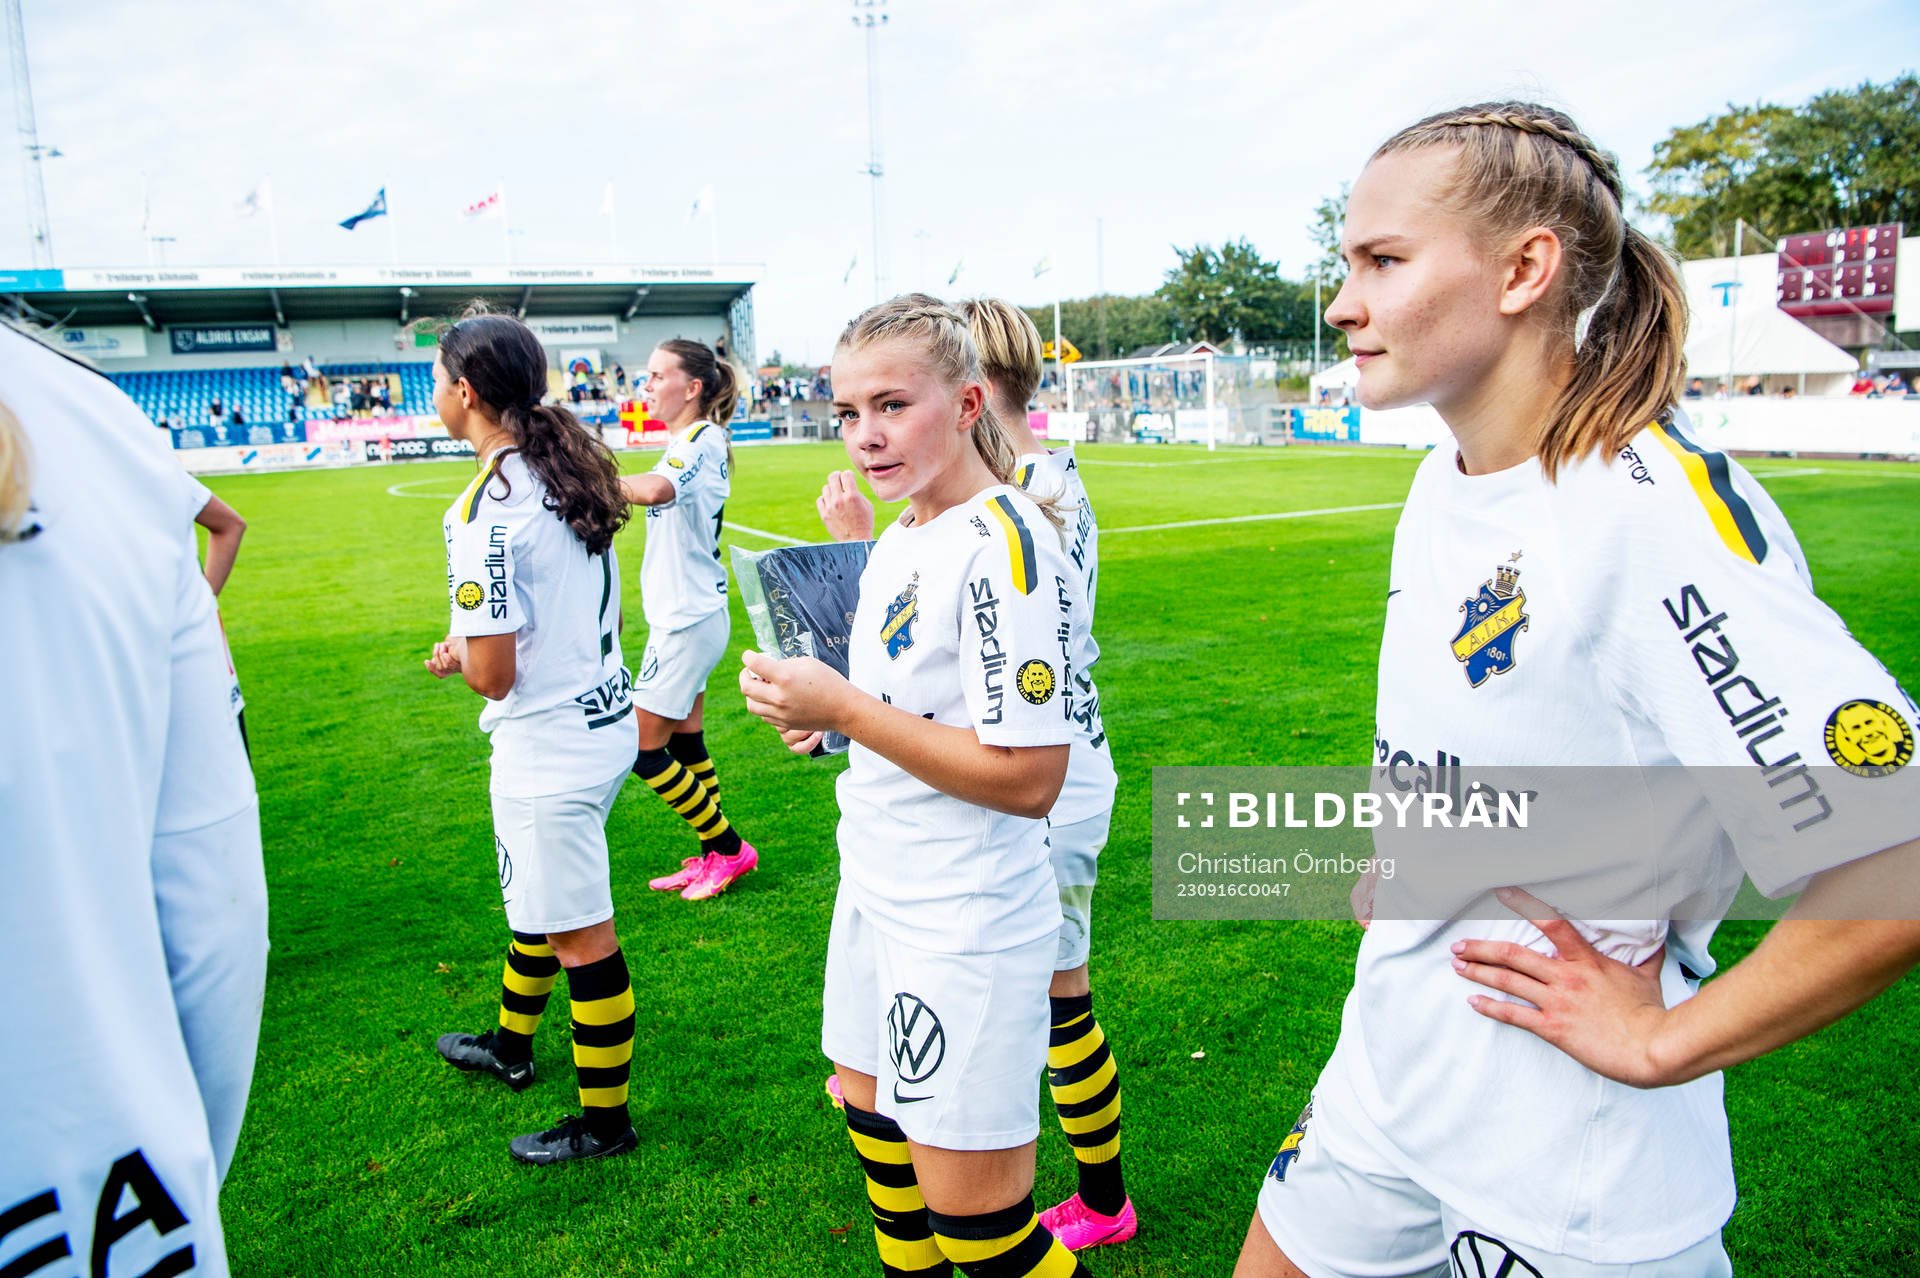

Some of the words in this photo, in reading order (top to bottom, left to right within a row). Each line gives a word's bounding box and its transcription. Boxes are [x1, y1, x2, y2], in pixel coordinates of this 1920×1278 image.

[485, 525, 508, 620] stadium
[969, 577, 1007, 725] stadium
[1662, 584, 1833, 832] stadium
